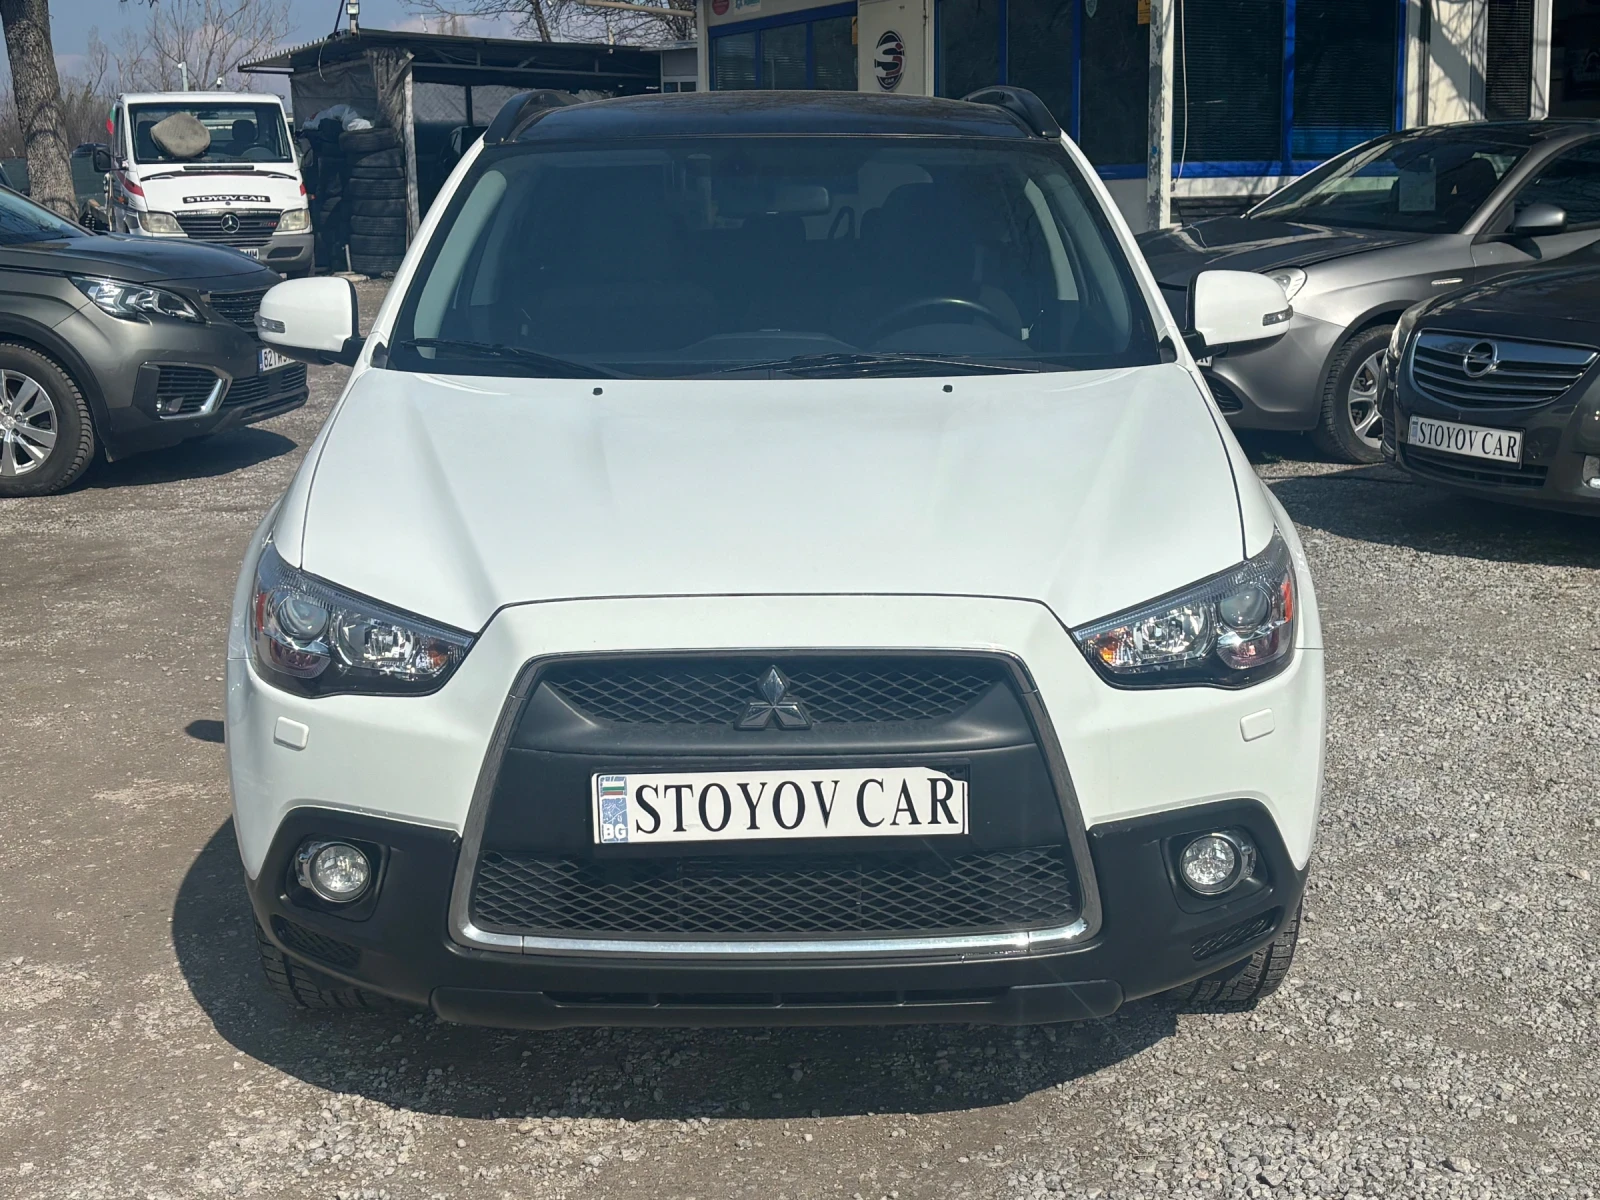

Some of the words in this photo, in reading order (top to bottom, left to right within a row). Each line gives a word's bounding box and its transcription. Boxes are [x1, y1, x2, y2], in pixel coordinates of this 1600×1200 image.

[1418, 421, 1479, 453] STOYOV
[1481, 432, 1517, 459] CAR
[634, 779, 841, 835] STOYOV
[856, 777, 959, 829] CAR
[603, 822, 628, 839] BG
